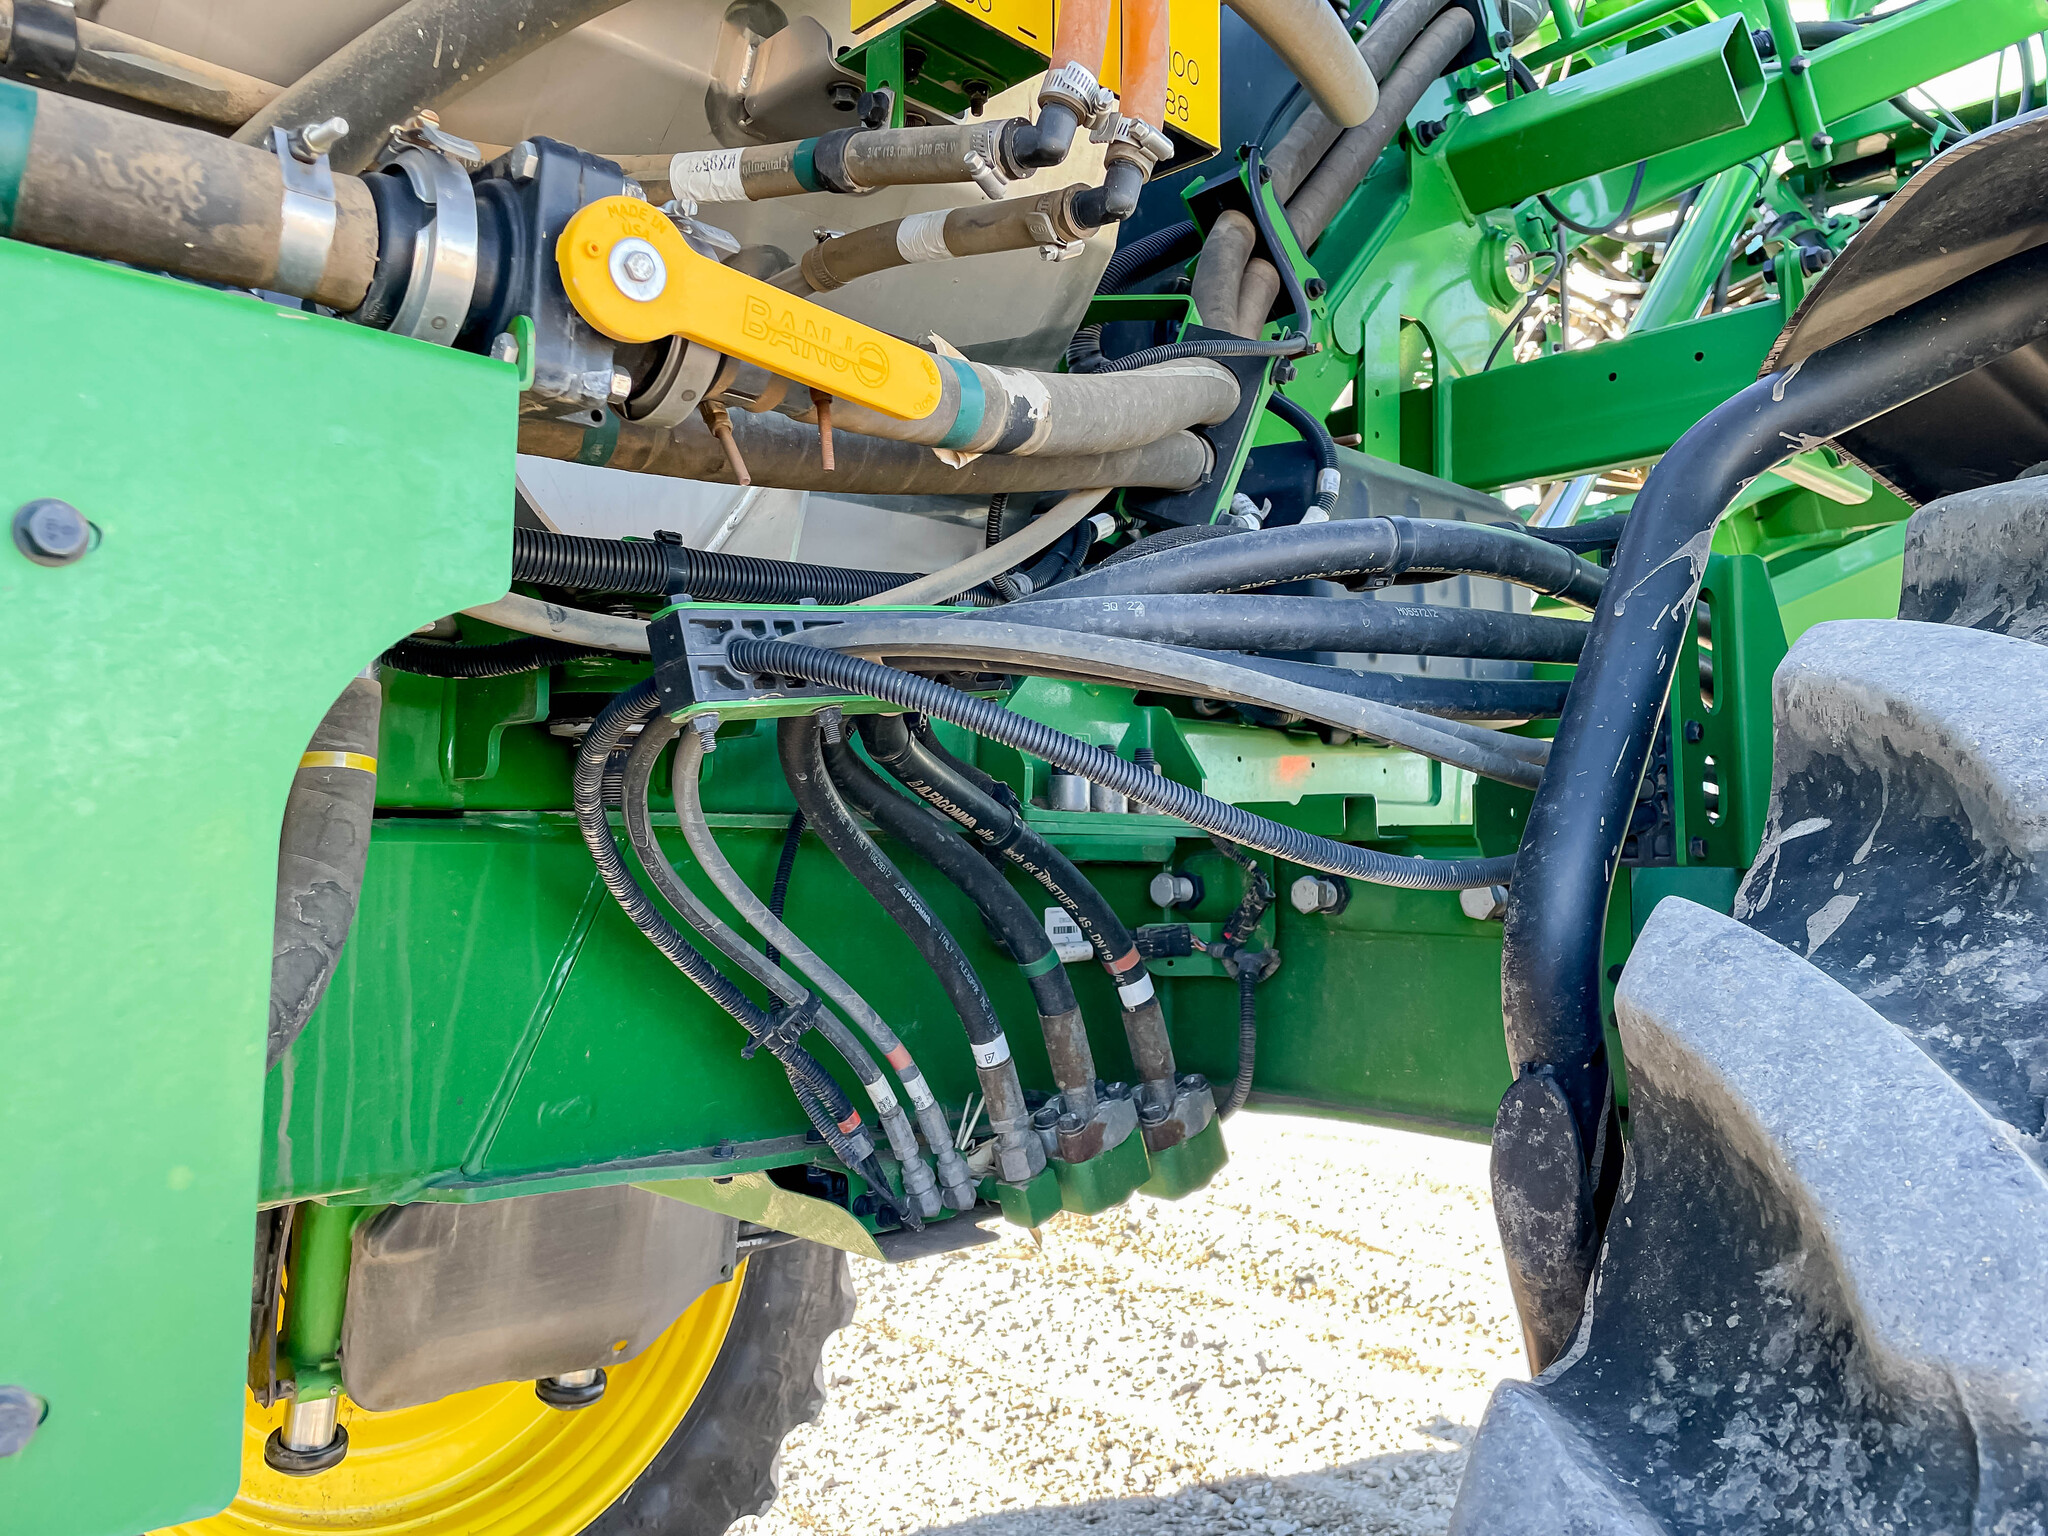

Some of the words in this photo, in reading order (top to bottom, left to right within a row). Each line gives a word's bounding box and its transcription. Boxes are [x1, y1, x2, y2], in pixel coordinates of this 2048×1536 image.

[607, 203, 648, 221] MADE
[650, 215, 668, 234] IN
[621, 222, 650, 240] USA
[742, 295, 890, 388] BANJO
[914, 784, 978, 830] ALFAGOMMA
[975, 827, 995, 842] alfa
[1022, 861, 1039, 873] 6K
[1034, 870, 1079, 916] MINETUFF
[1091, 933, 1107, 949] DN
[1101, 949, 1114, 961] 19
[897, 886, 931, 927] ALFAGOMMA
[938, 932, 954, 953] ITALY
